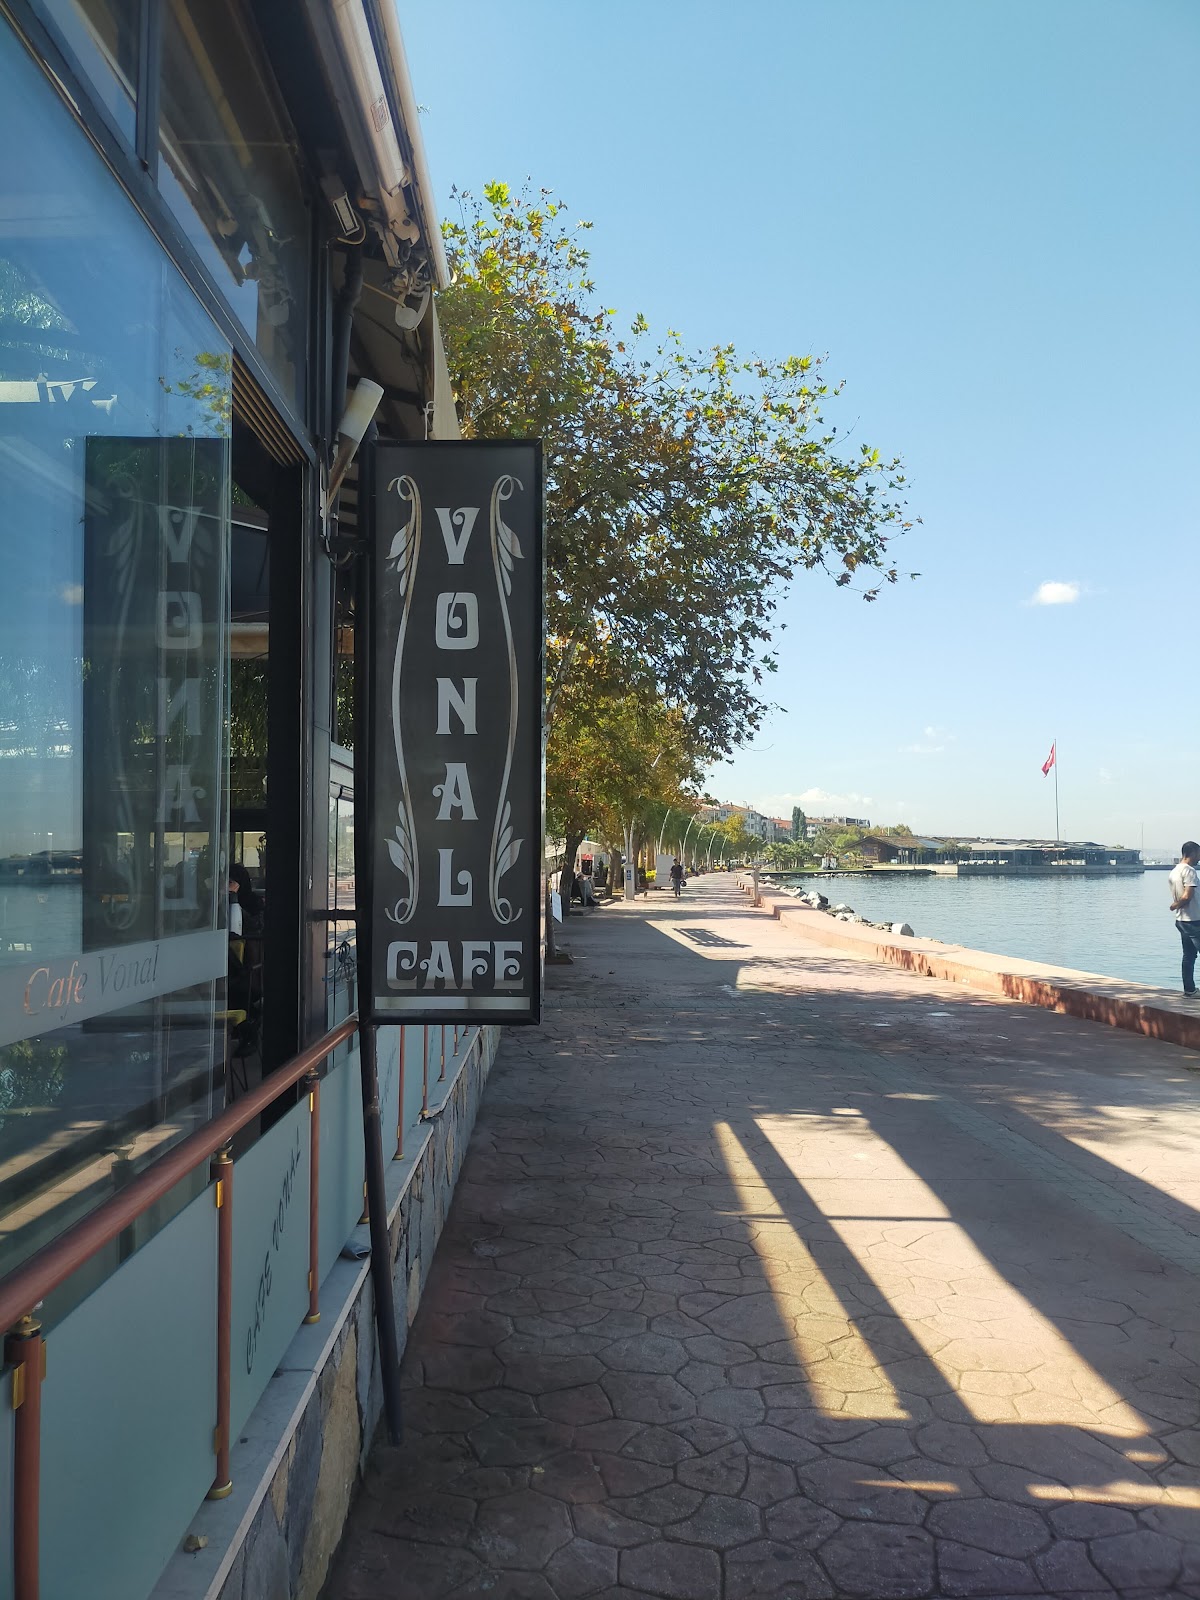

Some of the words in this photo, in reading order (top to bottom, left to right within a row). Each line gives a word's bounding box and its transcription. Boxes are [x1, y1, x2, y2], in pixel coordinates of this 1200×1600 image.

[433, 507, 480, 907] VONAL
[23, 960, 88, 1021] Cafe
[98, 944, 160, 996] Vonal
[387, 941, 524, 990] CAFE
